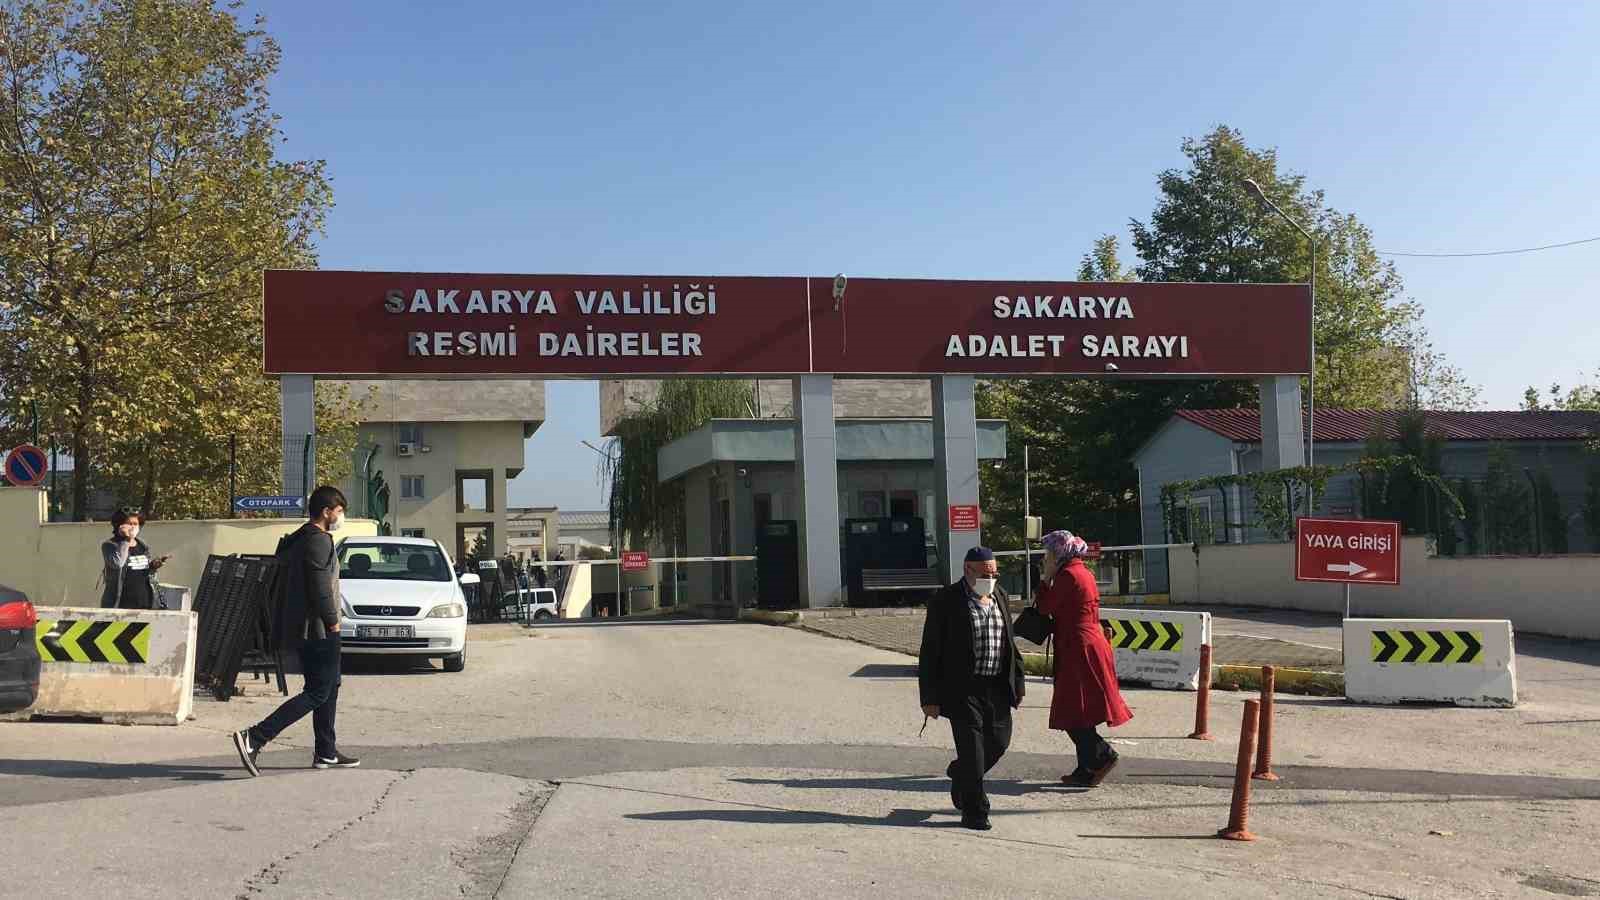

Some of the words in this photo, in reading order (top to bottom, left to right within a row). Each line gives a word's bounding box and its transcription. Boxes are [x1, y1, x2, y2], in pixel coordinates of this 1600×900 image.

[384, 289, 557, 315] SAKARYA
[574, 283, 716, 315] VALİLİĞİ
[993, 295, 1134, 319] SAKARYA
[408, 325, 517, 357] RESMİ
[539, 325, 704, 357] DAİRELER
[945, 334, 1065, 358] ADALET
[1082, 334, 1189, 358] SARAYI
[248, 498, 291, 506] OTOPARK
[1304, 533, 1344, 549] YAYA
[1347, 533, 1391, 553] GİRİŞİ
